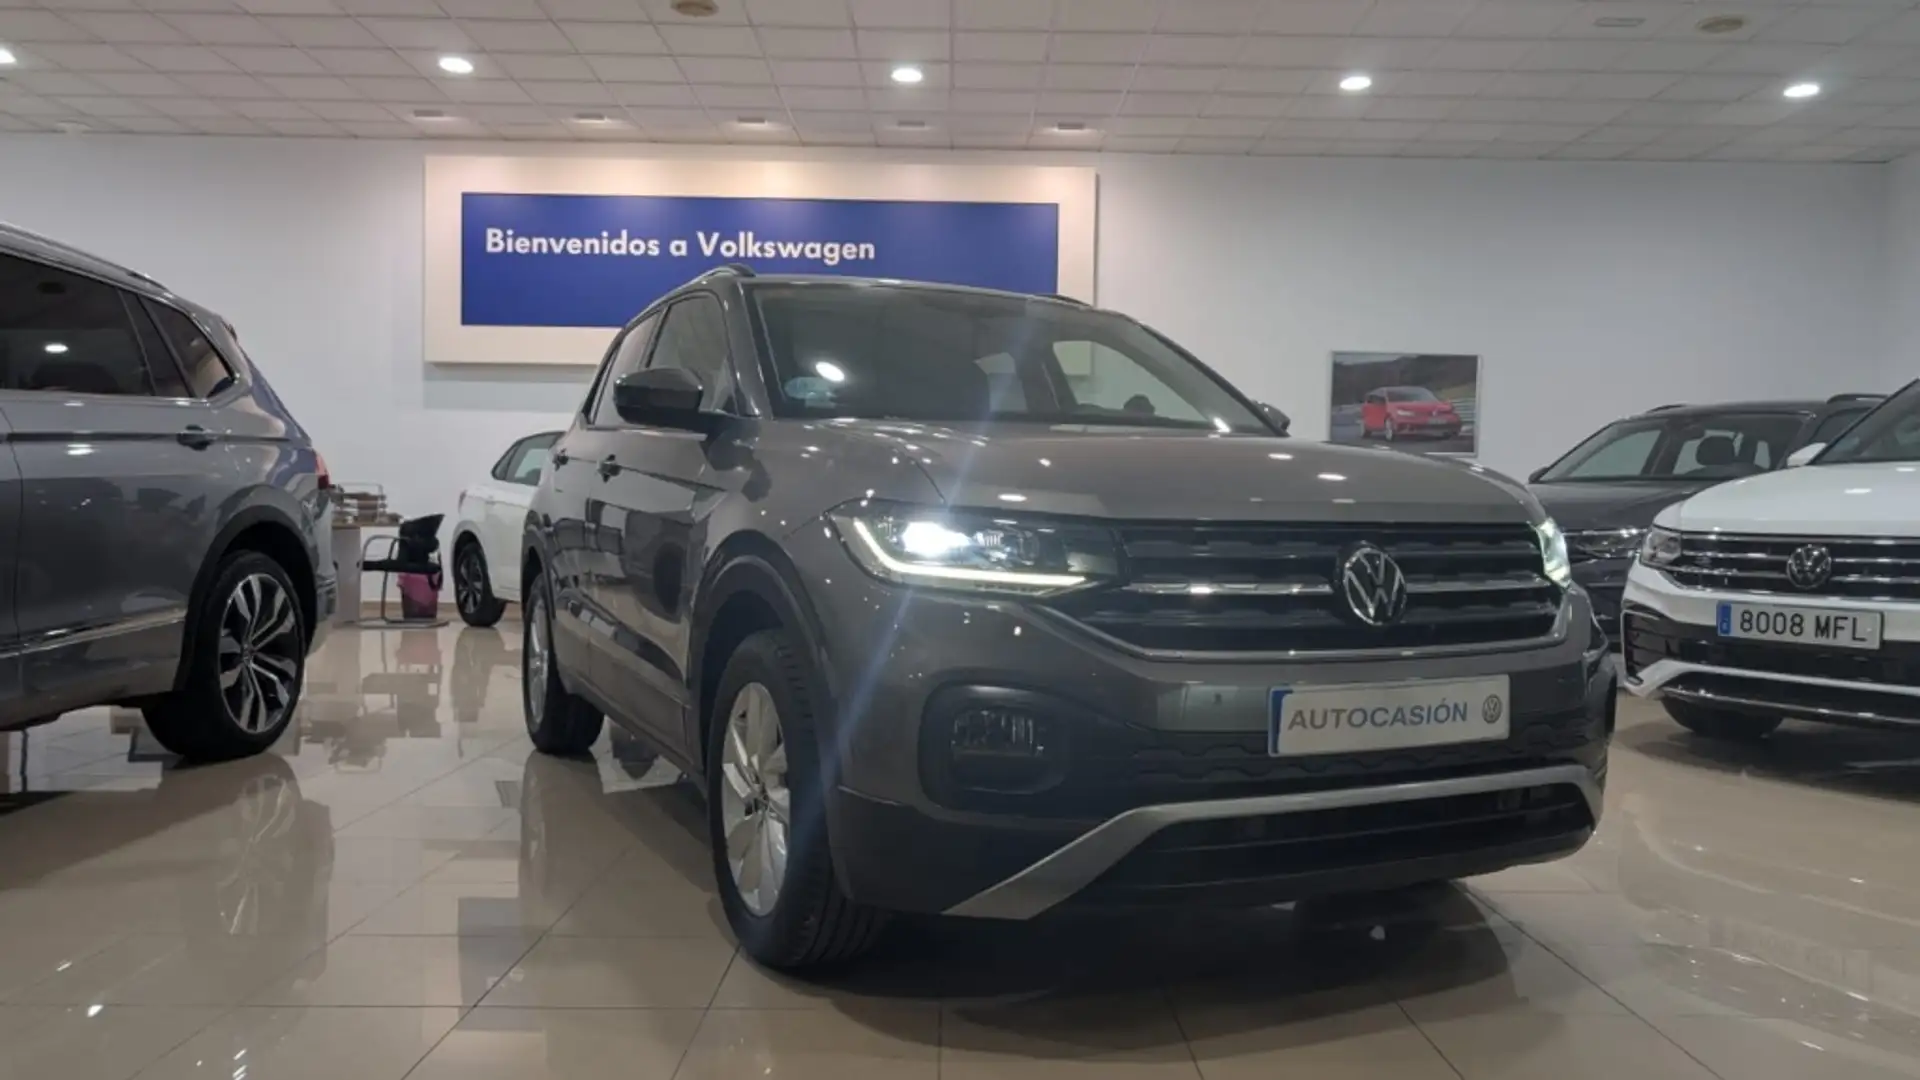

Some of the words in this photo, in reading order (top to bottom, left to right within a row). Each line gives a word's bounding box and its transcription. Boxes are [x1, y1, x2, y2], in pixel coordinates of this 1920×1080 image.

[486, 228, 660, 256] Bienvenidos
[669, 239, 688, 257] a
[697, 231, 876, 266] Volkswagen
[1740, 609, 1804, 637] 8008
[1814, 615, 1867, 642] MFL
[1287, 698, 1468, 731] AUTOCASIÓN
